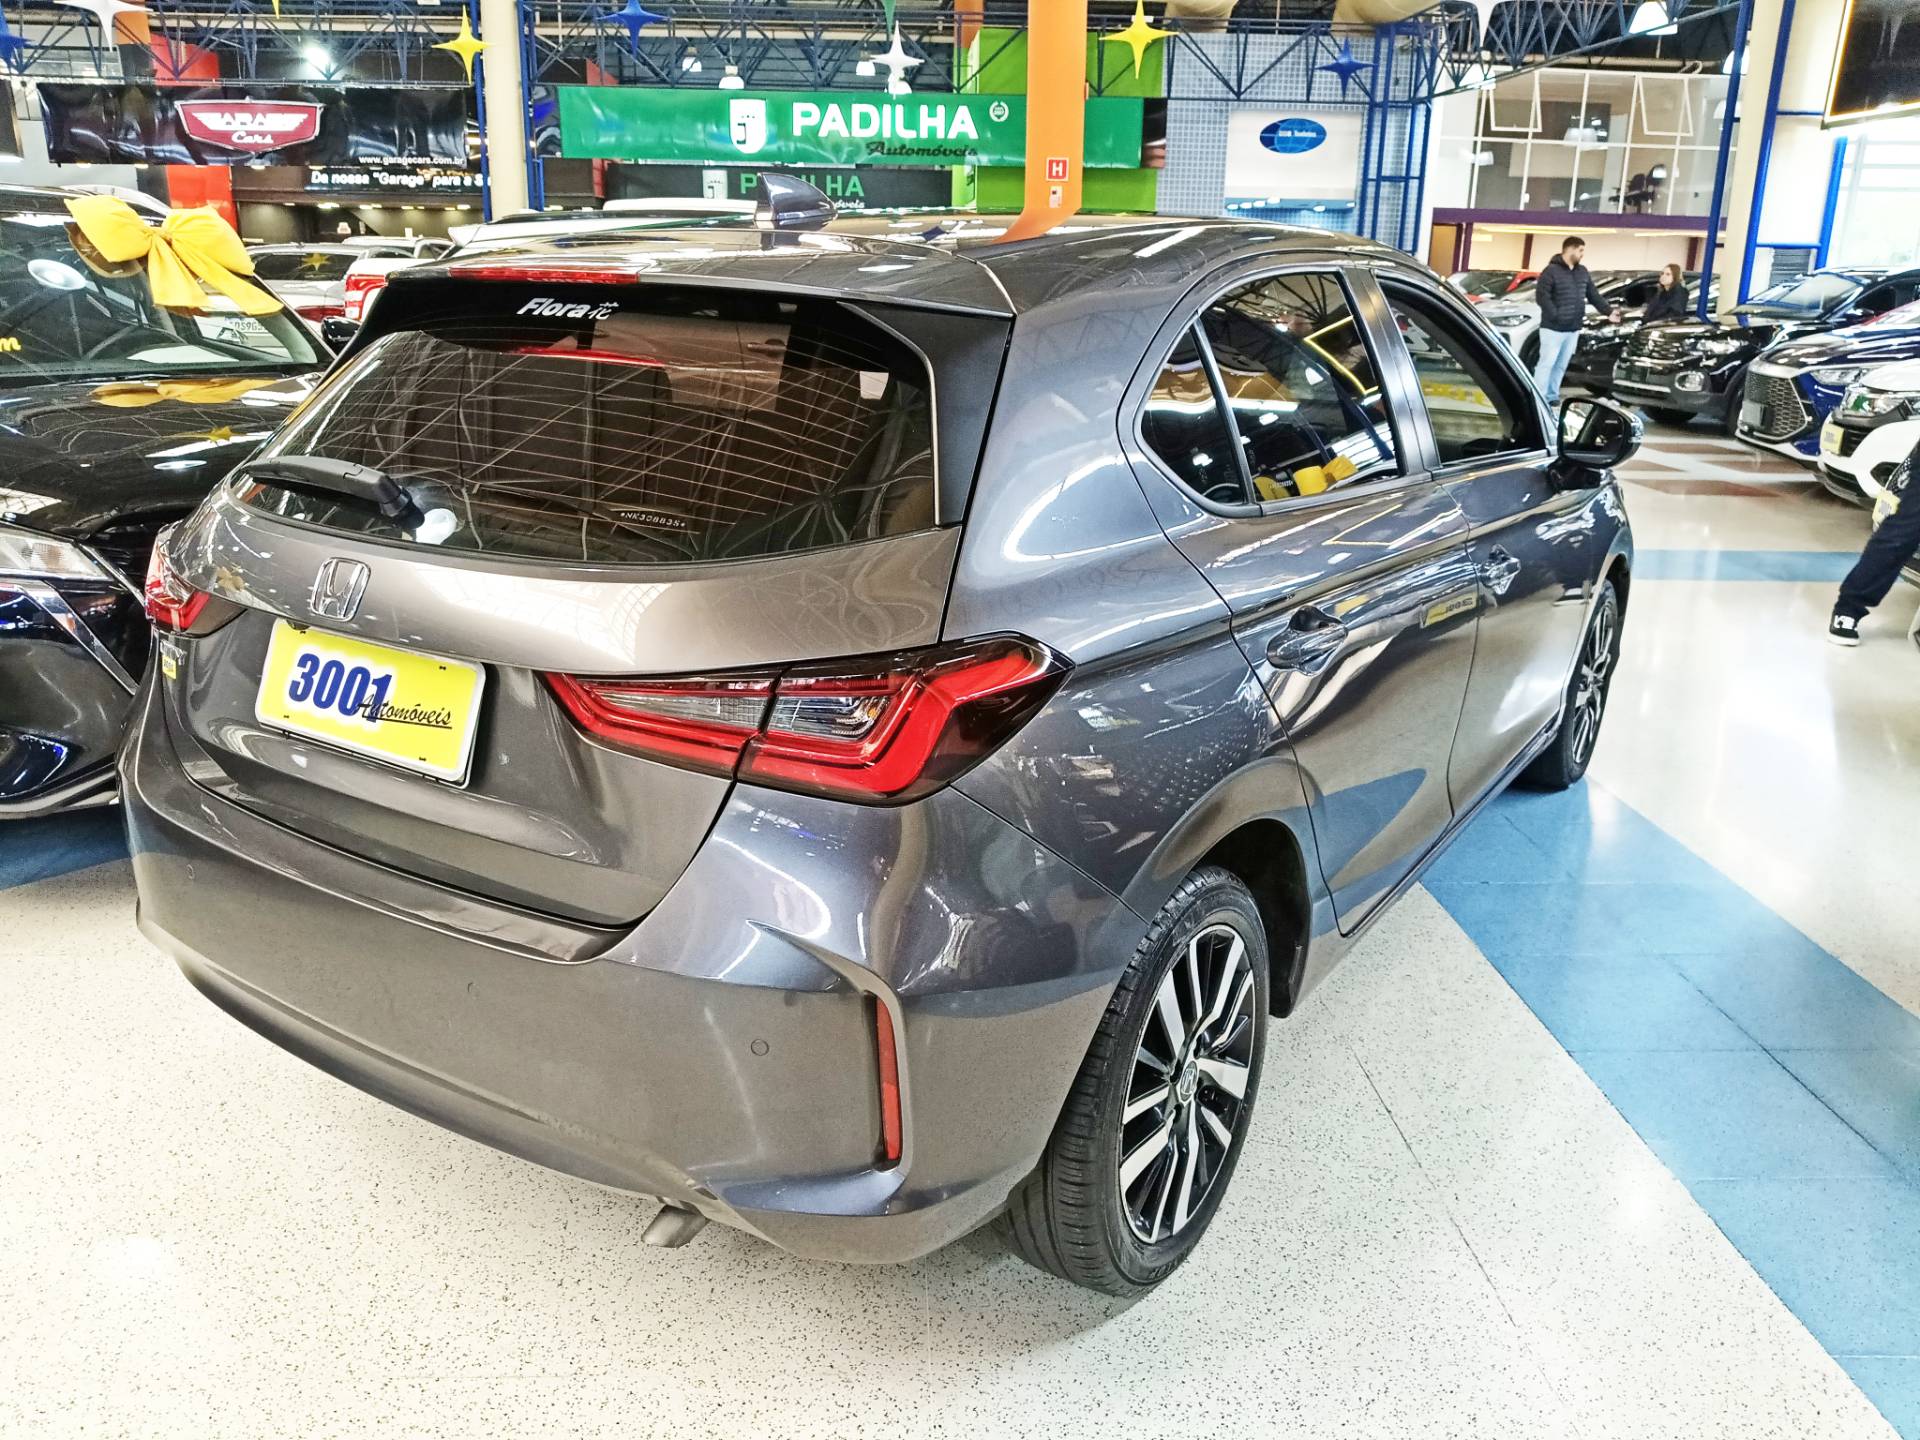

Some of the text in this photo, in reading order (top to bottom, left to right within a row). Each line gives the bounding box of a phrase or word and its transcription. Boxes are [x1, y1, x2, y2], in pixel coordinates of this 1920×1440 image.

[792, 102, 979, 139] PADILHA
[231, 131, 274, 144] Cars
[358, 155, 465, 166] www.garagecars.com.br
[1052, 161, 1063, 177] H
[311, 171, 329, 185] Da
[331, 173, 370, 185] nossa
[432, 174, 462, 188] para
[463, 175, 472, 186] a
[516, 298, 591, 318] Flora
[288, 653, 392, 723] 3001
[354, 694, 453, 729] Automóveis
